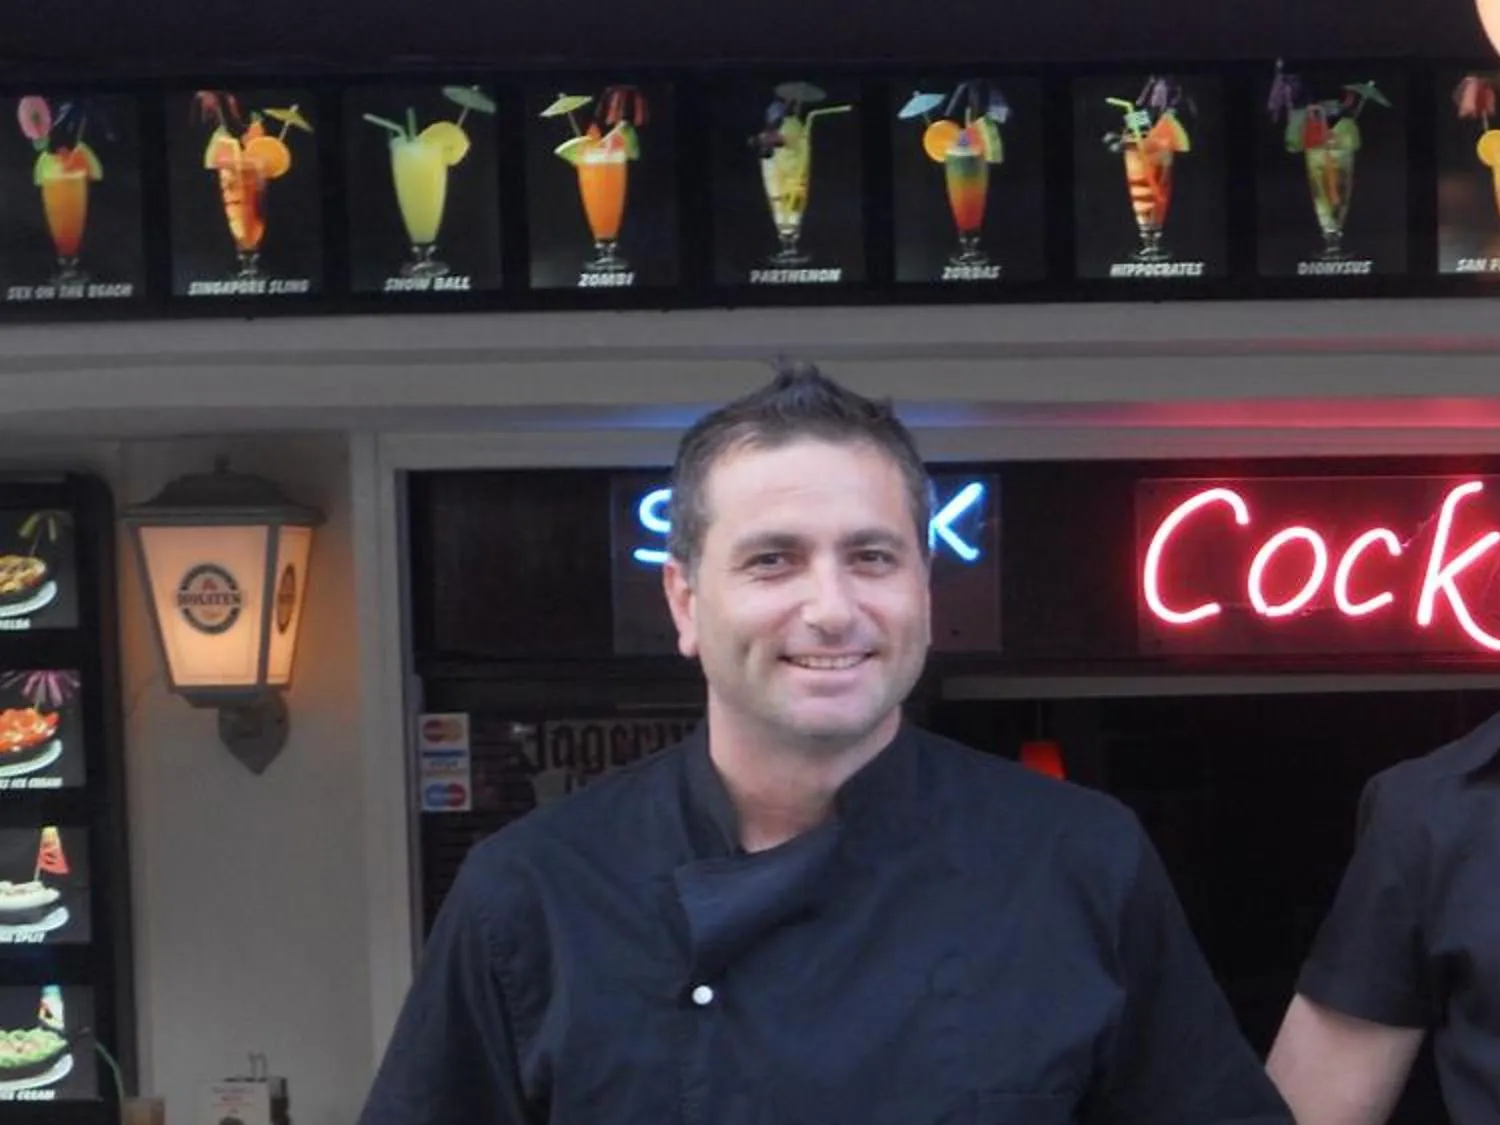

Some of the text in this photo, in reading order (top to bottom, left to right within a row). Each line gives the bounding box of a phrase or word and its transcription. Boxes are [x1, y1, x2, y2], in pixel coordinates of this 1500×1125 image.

[1110, 262, 1205, 277] HIPPOCRATES
[1297, 260, 1372, 275] DIONYSUS
[1456, 258, 1486, 272] SAN
[750, 268, 842, 283] PARTHENON
[942, 266, 1001, 280] ZORBAS
[187, 279, 310, 296] SINGAPORE SLING
[384, 276, 472, 291] SNOW BALL
[8, 283, 134, 300] SEX ON THE BEACH
